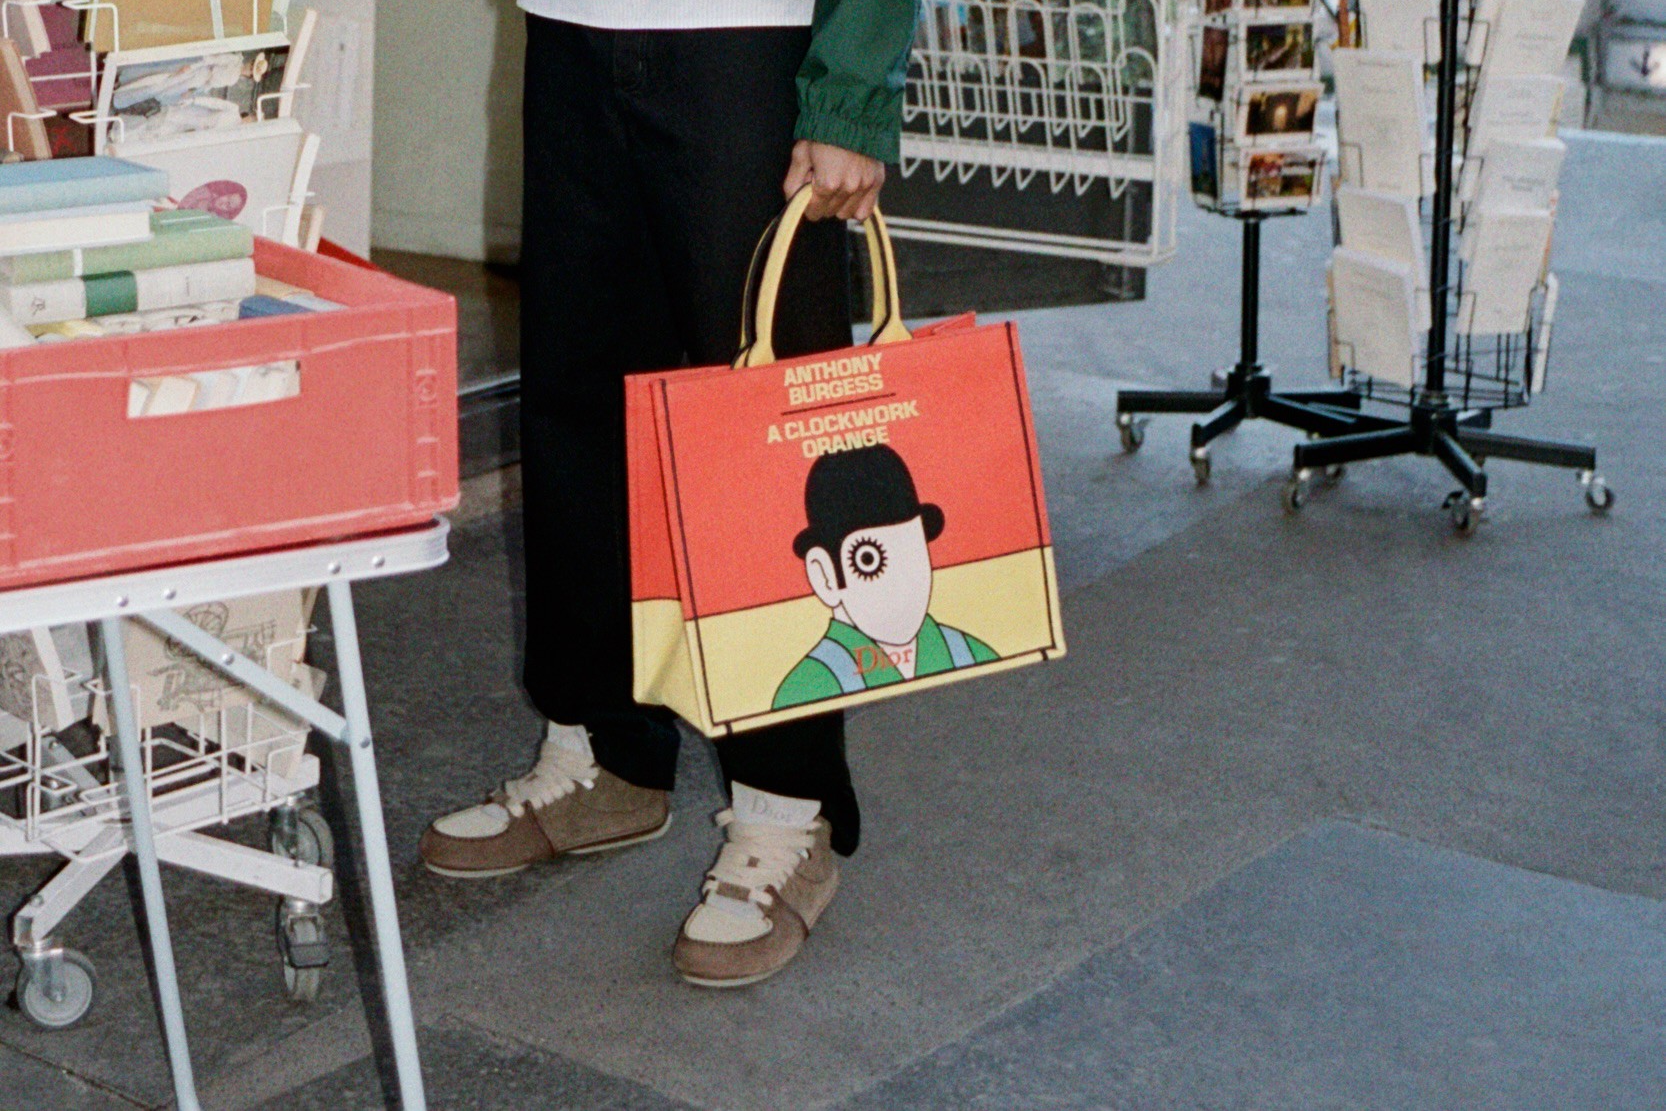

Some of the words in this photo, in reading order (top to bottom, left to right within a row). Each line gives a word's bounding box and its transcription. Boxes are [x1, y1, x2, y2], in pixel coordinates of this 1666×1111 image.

[784, 353, 882, 386] ANTHONY
[788, 373, 884, 406] BURGESS
[767, 424, 783, 444] A
[784, 399, 920, 440] CLOCKWORK
[802, 425, 891, 459] ORANGE
[853, 645, 913, 675] Dior
